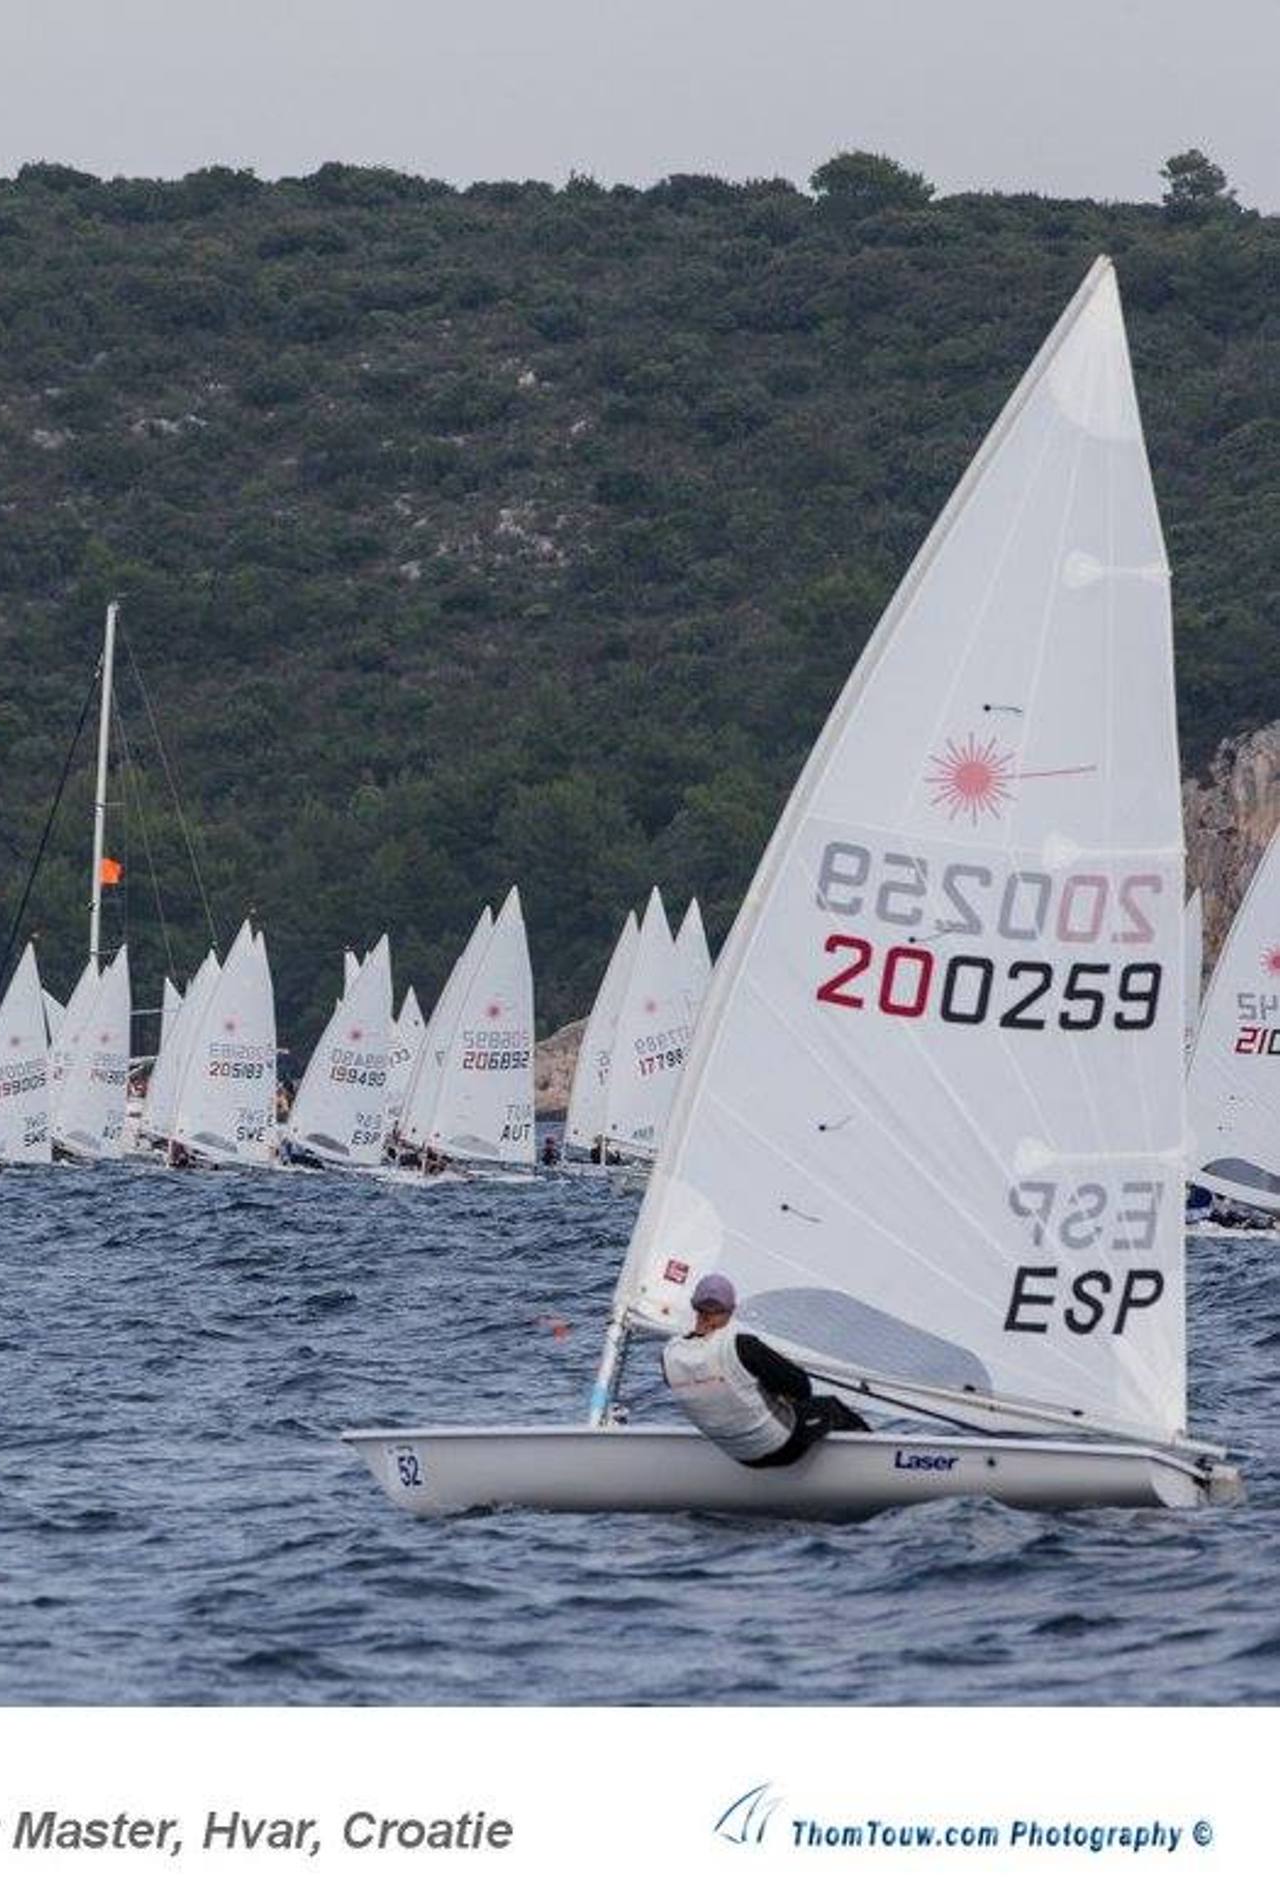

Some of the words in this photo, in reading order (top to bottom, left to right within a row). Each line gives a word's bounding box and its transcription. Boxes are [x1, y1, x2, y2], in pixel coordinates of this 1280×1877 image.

[815, 933, 1163, 1031] 200259
[1003, 1266, 1165, 1335] ESP
[397, 1455, 423, 1487] 52
[893, 1450, 959, 1471] Laser
